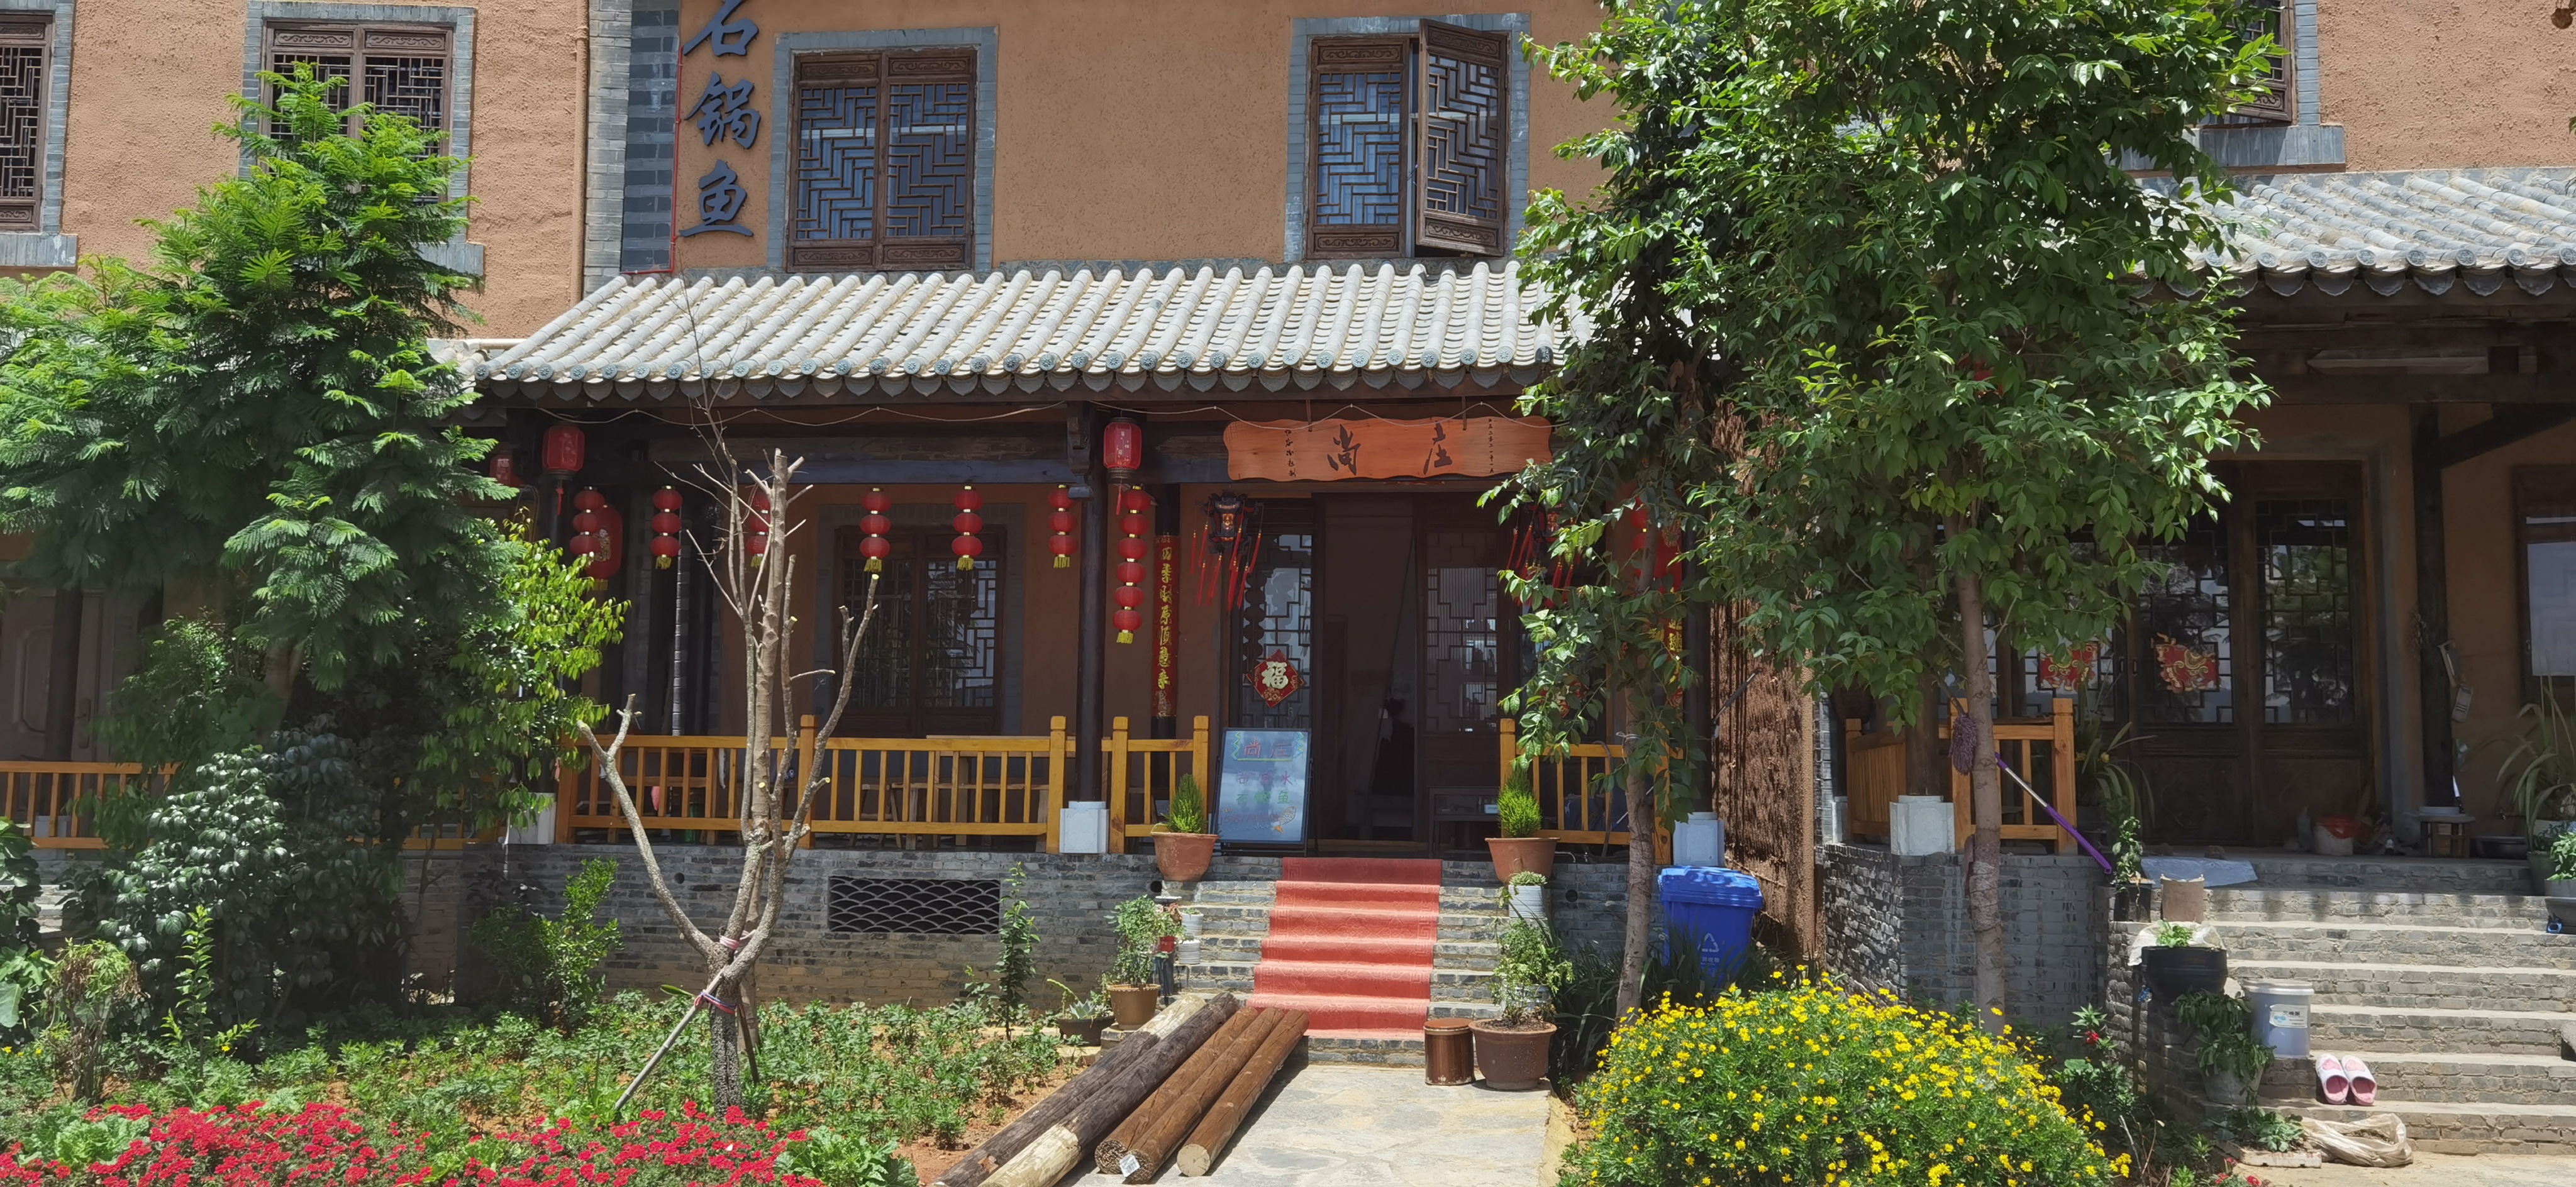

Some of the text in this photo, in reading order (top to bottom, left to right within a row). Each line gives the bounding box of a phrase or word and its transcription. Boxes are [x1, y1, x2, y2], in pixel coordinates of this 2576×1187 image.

[679, 0, 762, 238] 石锅鱼
[1261, 661, 1289, 690] 福
